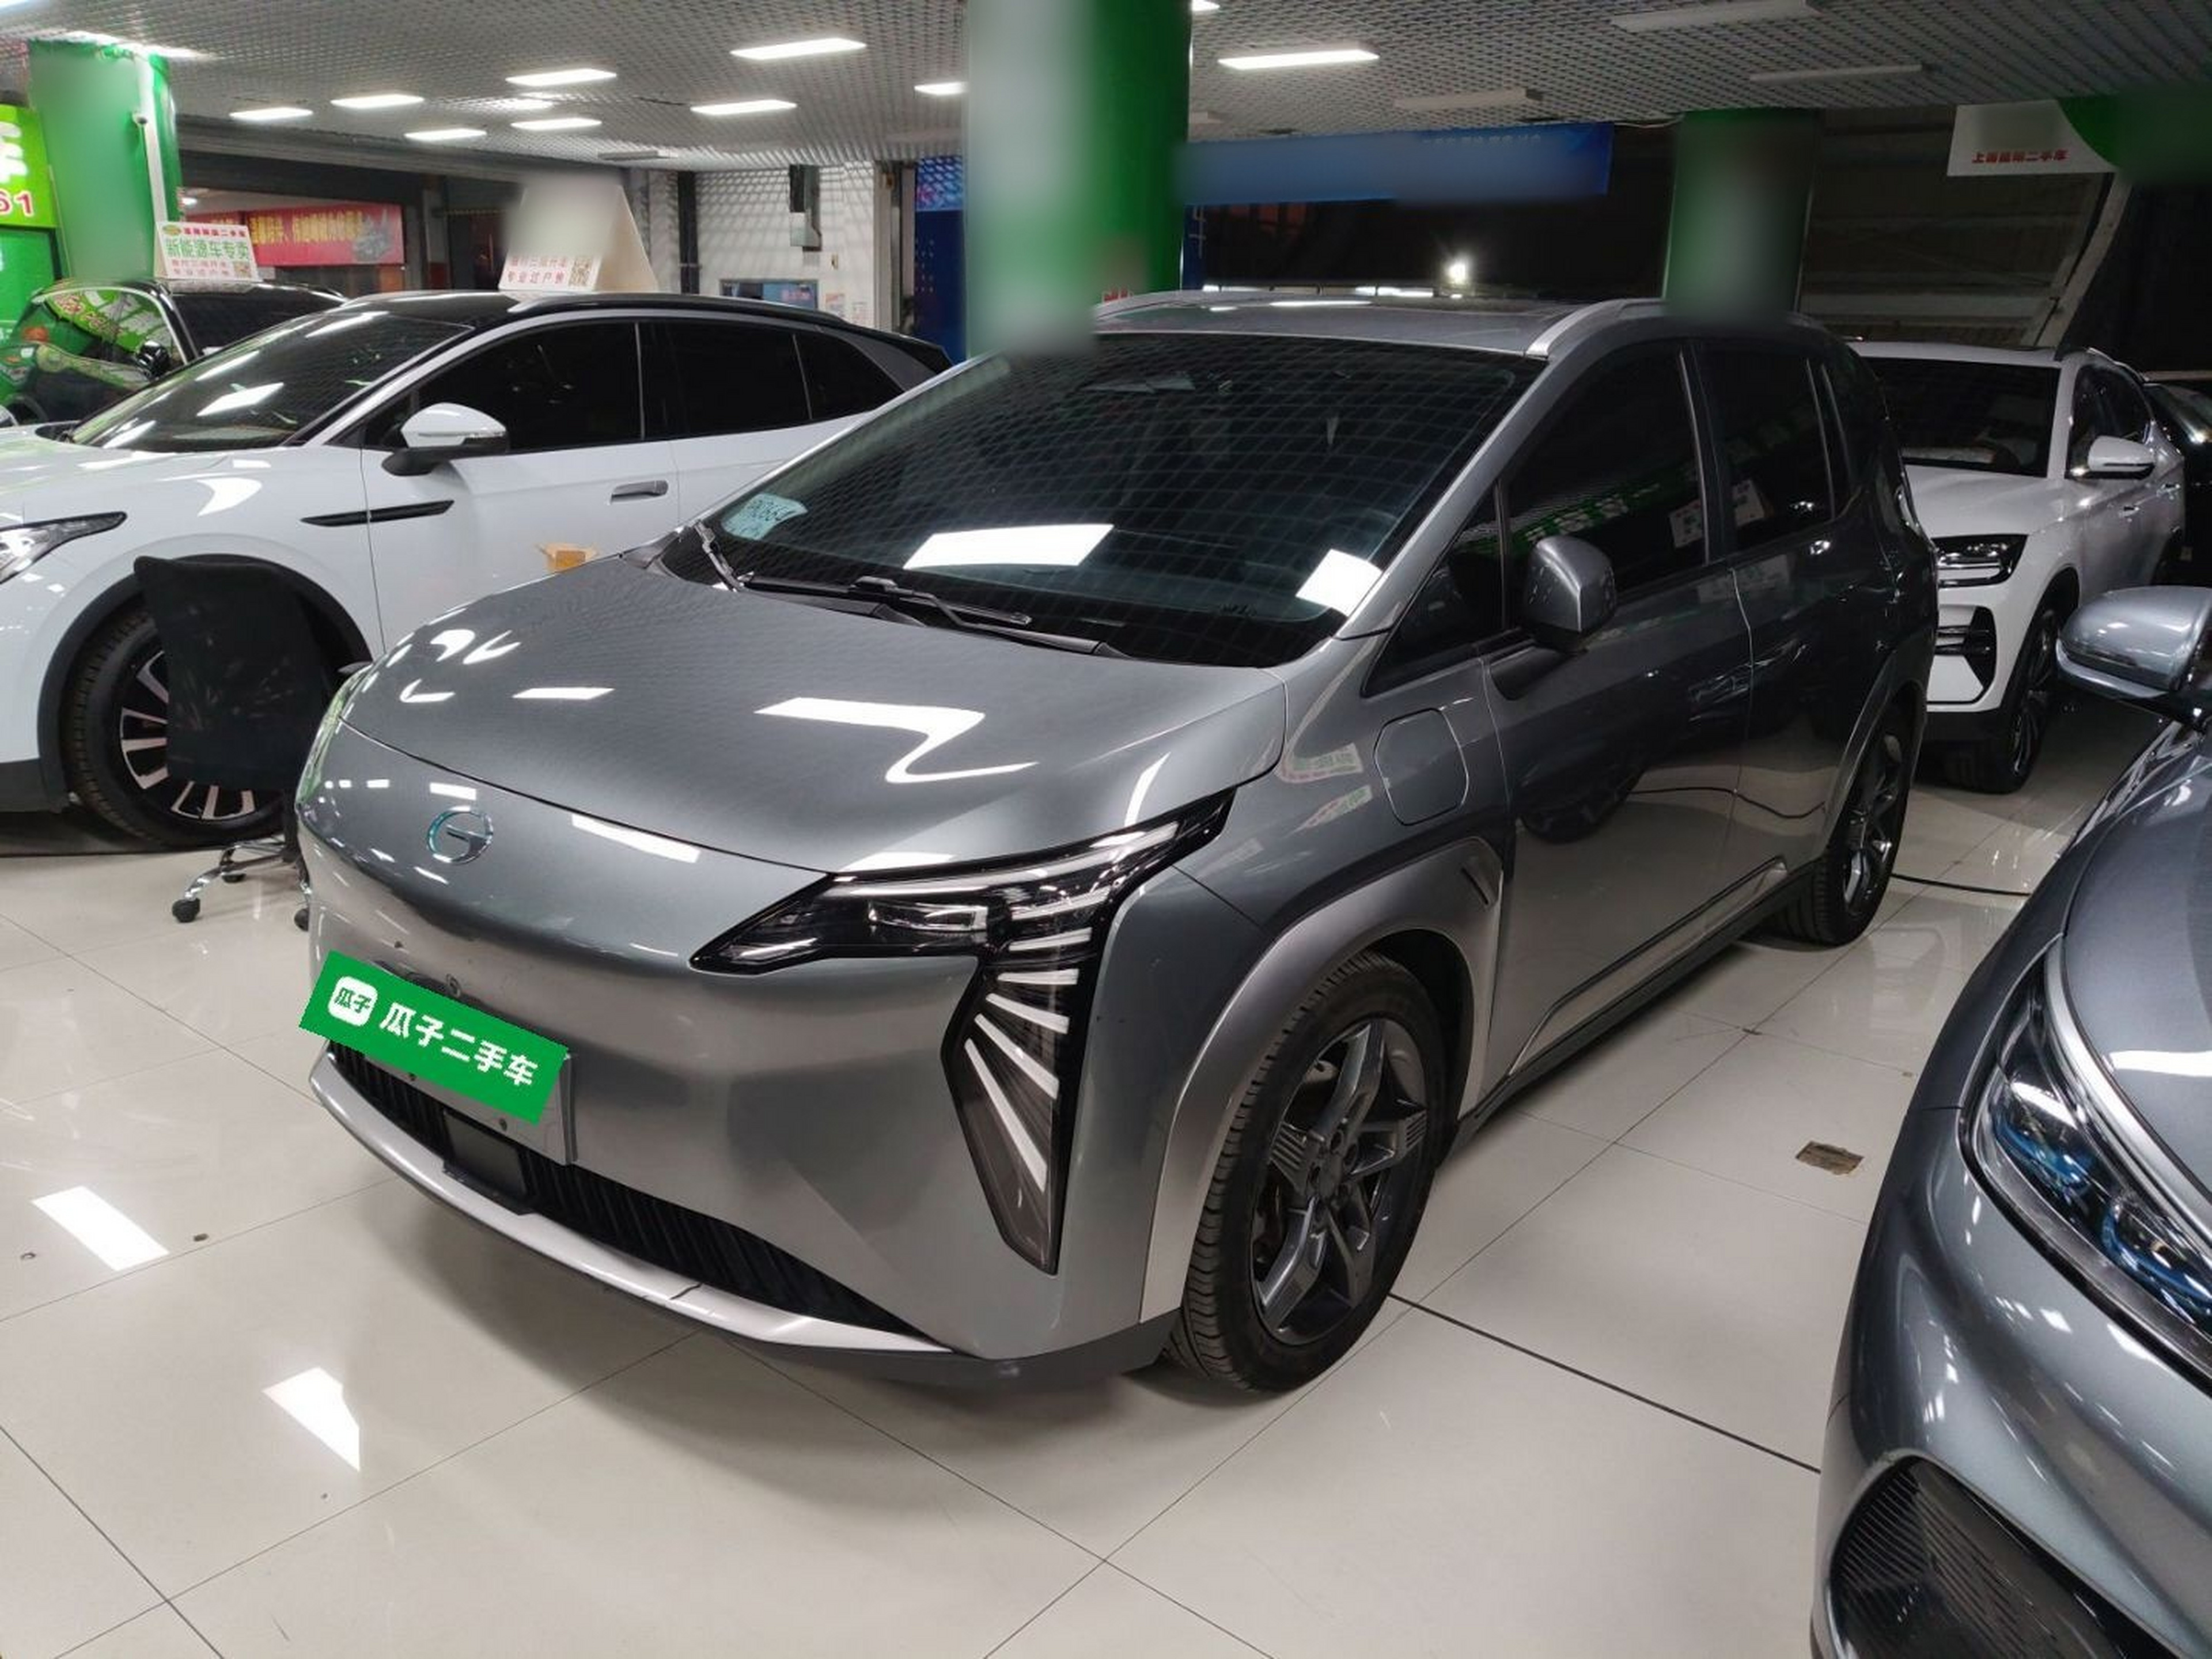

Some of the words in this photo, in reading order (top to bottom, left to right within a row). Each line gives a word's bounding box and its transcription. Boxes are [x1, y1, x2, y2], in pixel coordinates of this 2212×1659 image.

[165, 237, 249, 260] 新能源车专卖
